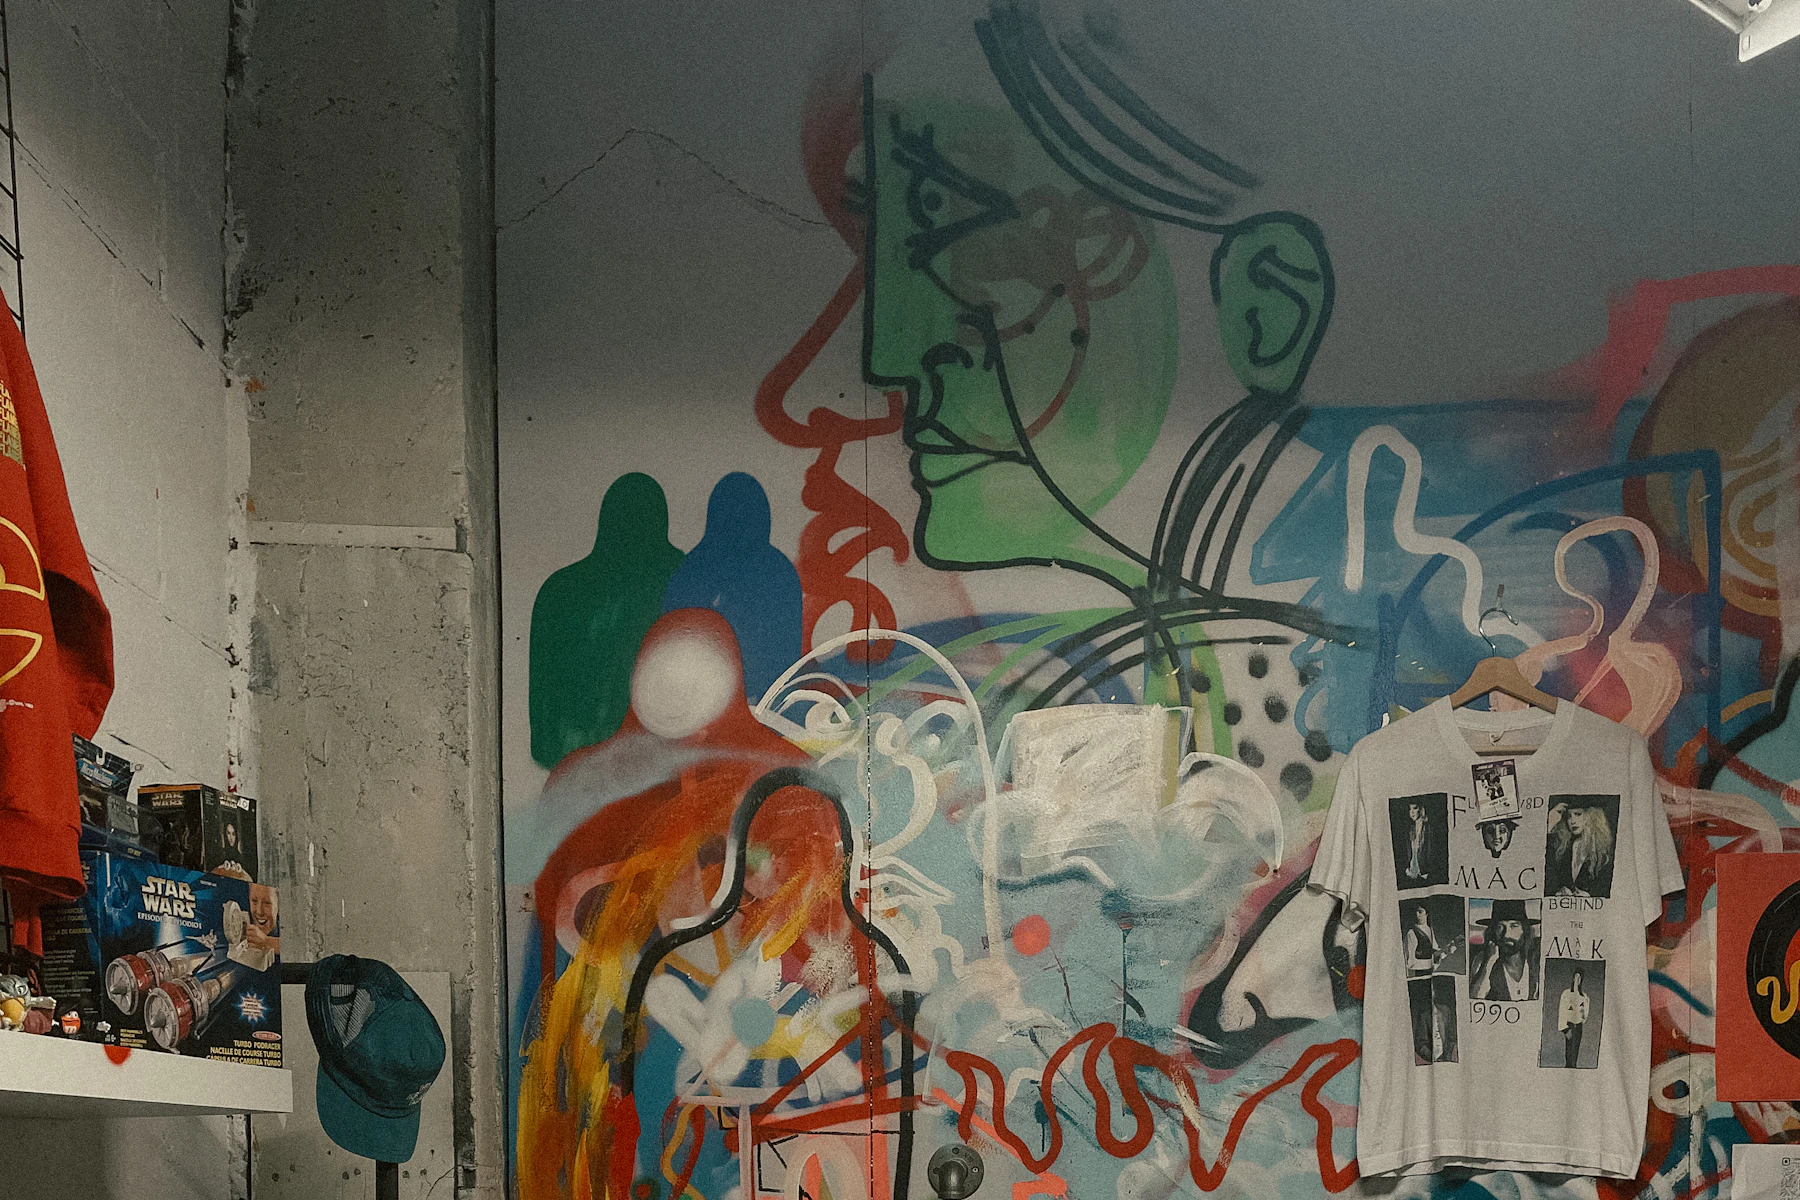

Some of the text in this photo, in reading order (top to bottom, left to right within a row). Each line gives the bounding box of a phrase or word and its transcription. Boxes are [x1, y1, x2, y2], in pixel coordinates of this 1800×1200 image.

[141, 876, 196, 902] STAR
[1454, 865, 1538, 890] MAC
[141, 893, 197, 919] WARS
[1549, 898, 1604, 910] BEHIND
[1469, 1001, 1520, 1026] 1990
[210, 1046, 281, 1059] NACELLE DE COURSE TURBO
[233, 1039, 281, 1050] TURBO PODRACER
